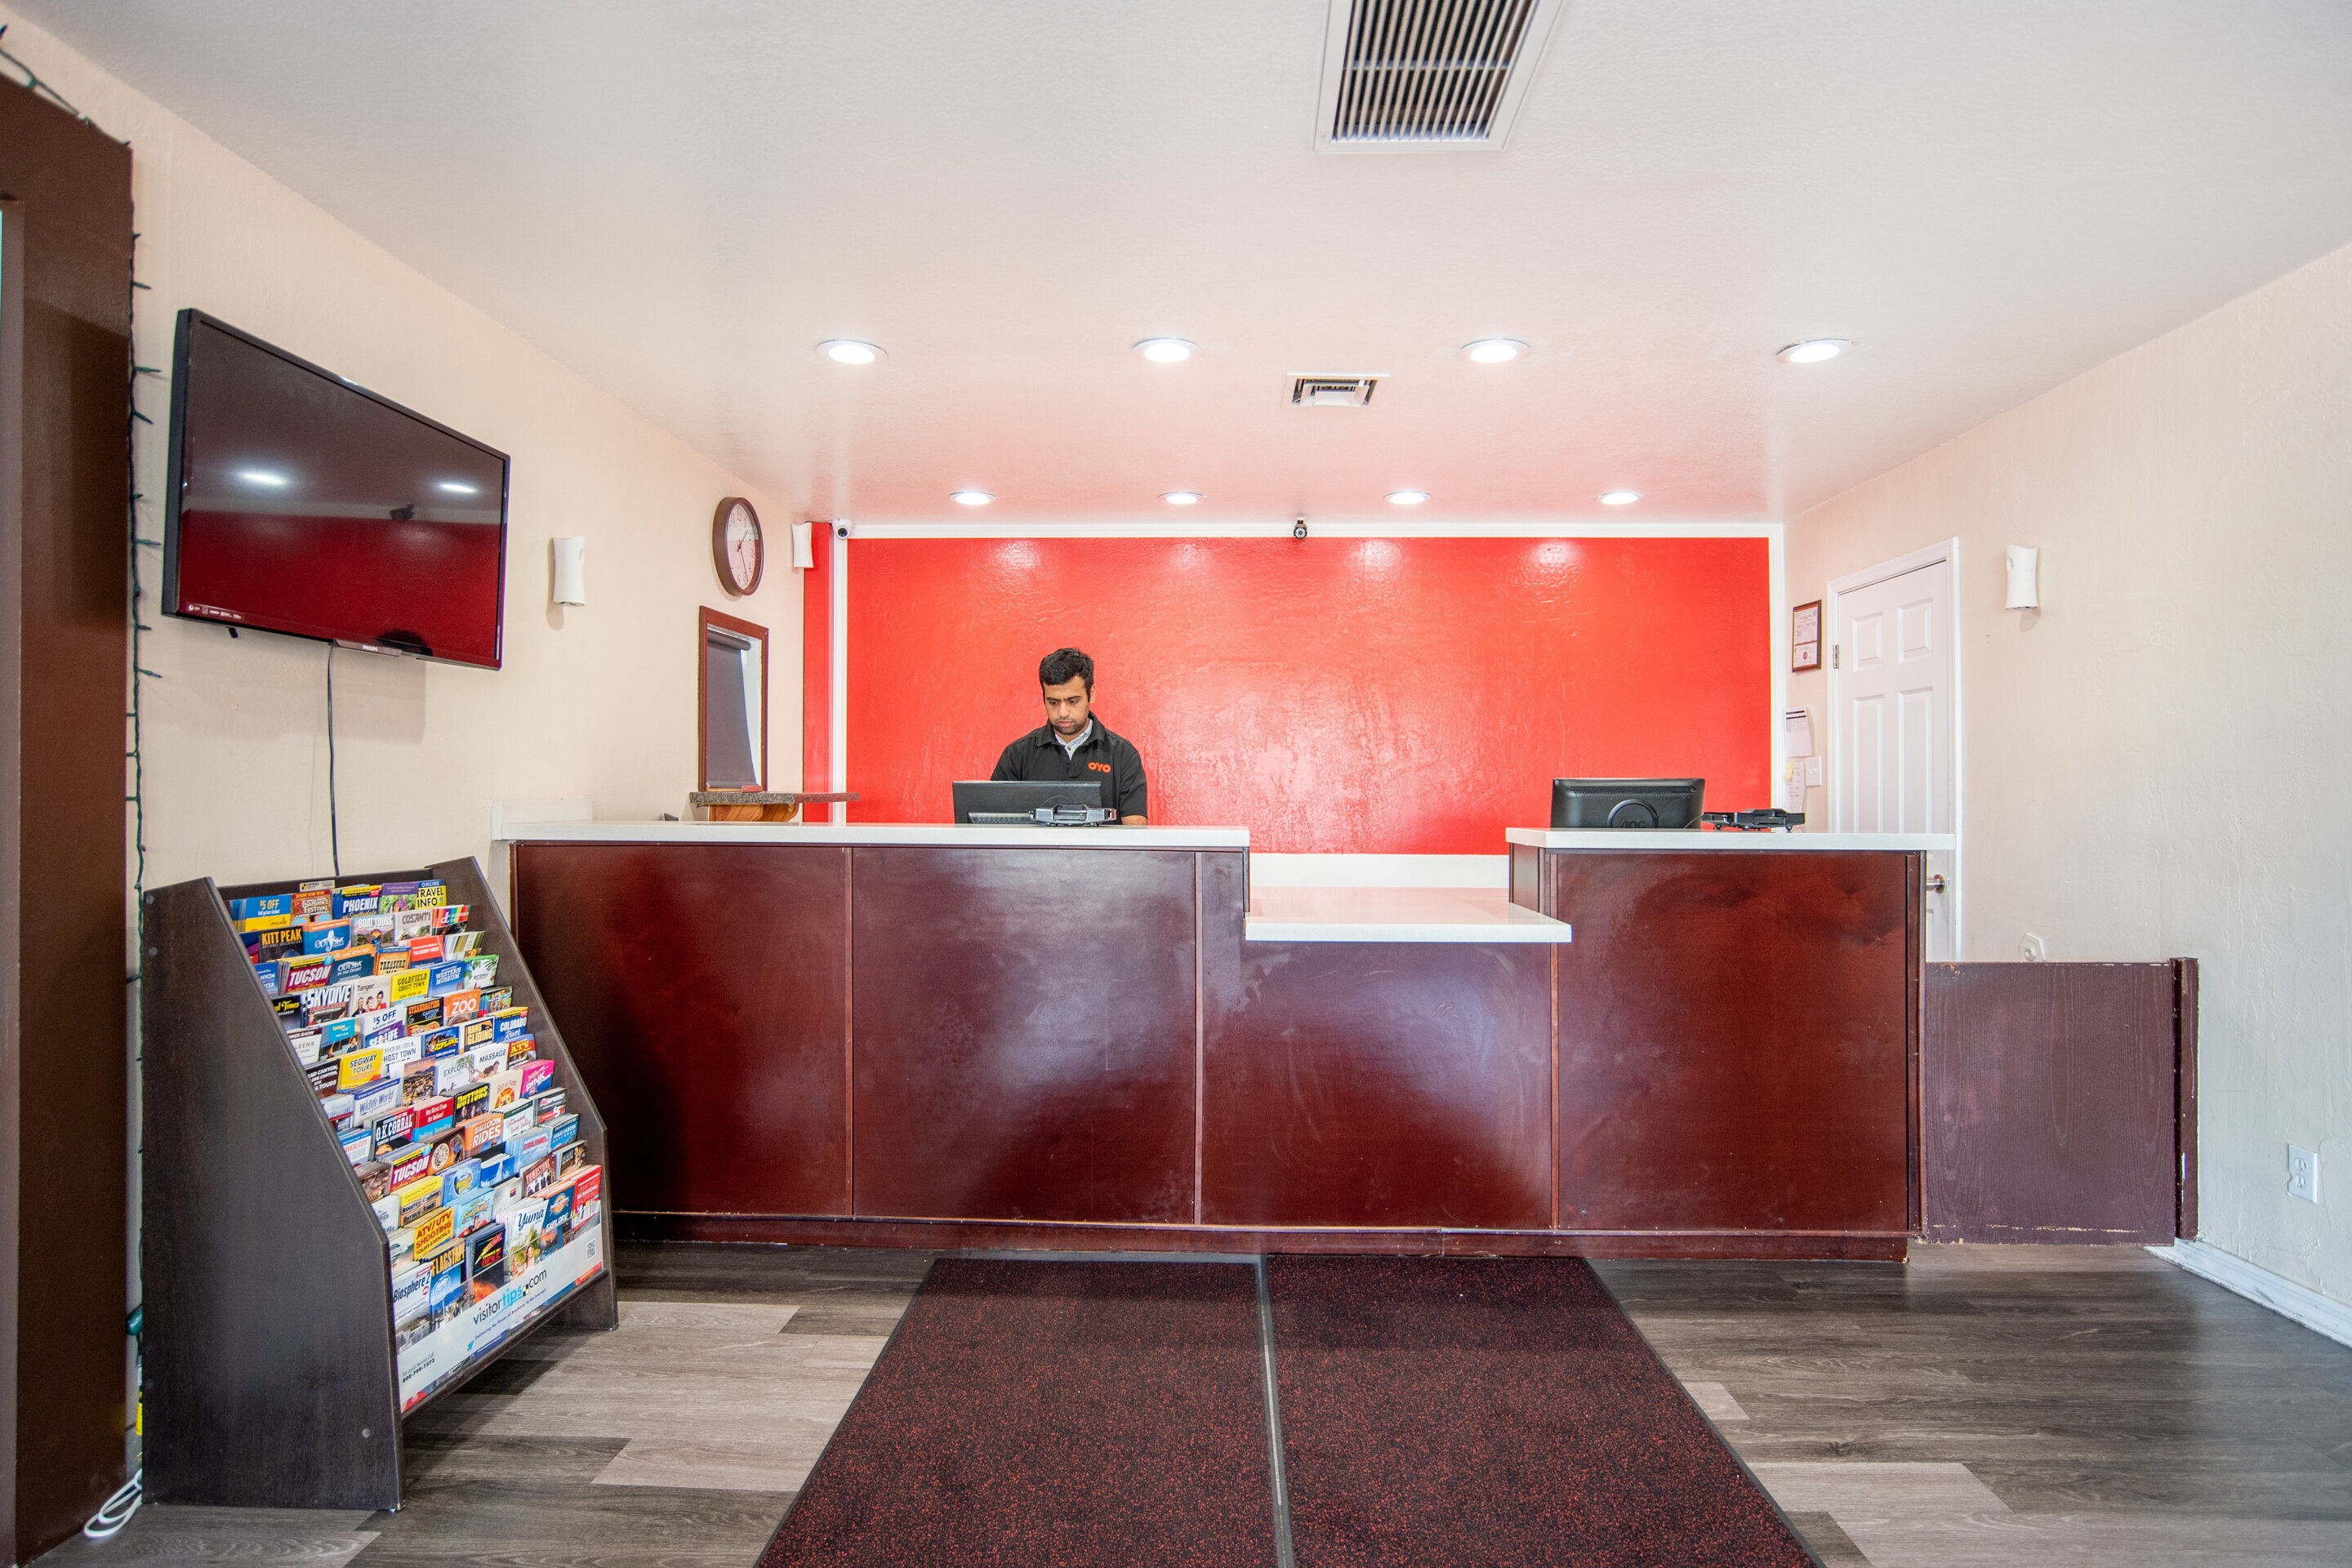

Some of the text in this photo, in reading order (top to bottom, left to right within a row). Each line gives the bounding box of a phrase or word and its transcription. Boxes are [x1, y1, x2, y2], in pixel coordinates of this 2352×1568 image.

[1088, 761, 1111, 773] OYO
[417, 887, 443, 898] TRAVEL
[267, 899, 279, 909] OFF
[343, 897, 378, 913] PHOENIX
[417, 898, 438, 908] INFO
[402, 911, 430, 924] COSANTI
[261, 929, 302, 946] KITT PEAK
[289, 965, 332, 987] TUCSON
[398, 973, 427, 986] GOLDFIELD
[436, 967, 461, 978] WESTERN
[436, 974, 460, 985] MUSEUM
[357, 983, 374, 991] Tanger
[399, 982, 412, 991] GHOST
[307, 985, 351, 1009] SKYDIVE
[452, 993, 478, 1001] PHOENIX
[282, 1000, 300, 1012] Times
[451, 998, 476, 1015] ZOO
[373, 1009, 396, 1025] $5 OFF
[468, 1022, 482, 1034] HANG
[500, 1017, 527, 1032] COLORADO
[468, 1028, 492, 1046] GLIDING
[504, 1029, 521, 1041] River
[510, 1041, 530, 1054] ATV
[350, 1054, 377, 1068] SEGWAY
[383, 1048, 416, 1062] HOST TOWN
[479, 1049, 506, 1062] MASSAGE
[353, 1063, 373, 1074] TOURS
[443, 1062, 468, 1076] EXPLORE
[319, 1080, 336, 1089] TOURS
[526, 1071, 550, 1092] PINK
[359, 1097, 377, 1112] Wildlife
[379, 1089, 394, 1104] World
[388, 1114, 413, 1136] CORRAL
[474, 1117, 501, 1134] BALLOON
[472, 1125, 501, 1148] RIDES
[393, 1155, 430, 1184] TUCSON
[416, 1210, 452, 1240] ATV/UTV
[519, 1209, 545, 1231] Yuma
[546, 1212, 569, 1232] EXPLORE
[416, 1221, 451, 1249] SHOOTING
[432, 1241, 466, 1276] FLAGSTAFF
[393, 1271, 431, 1303] Biosphere 2
[403, 1357, 435, 1383] 800-799-7373
